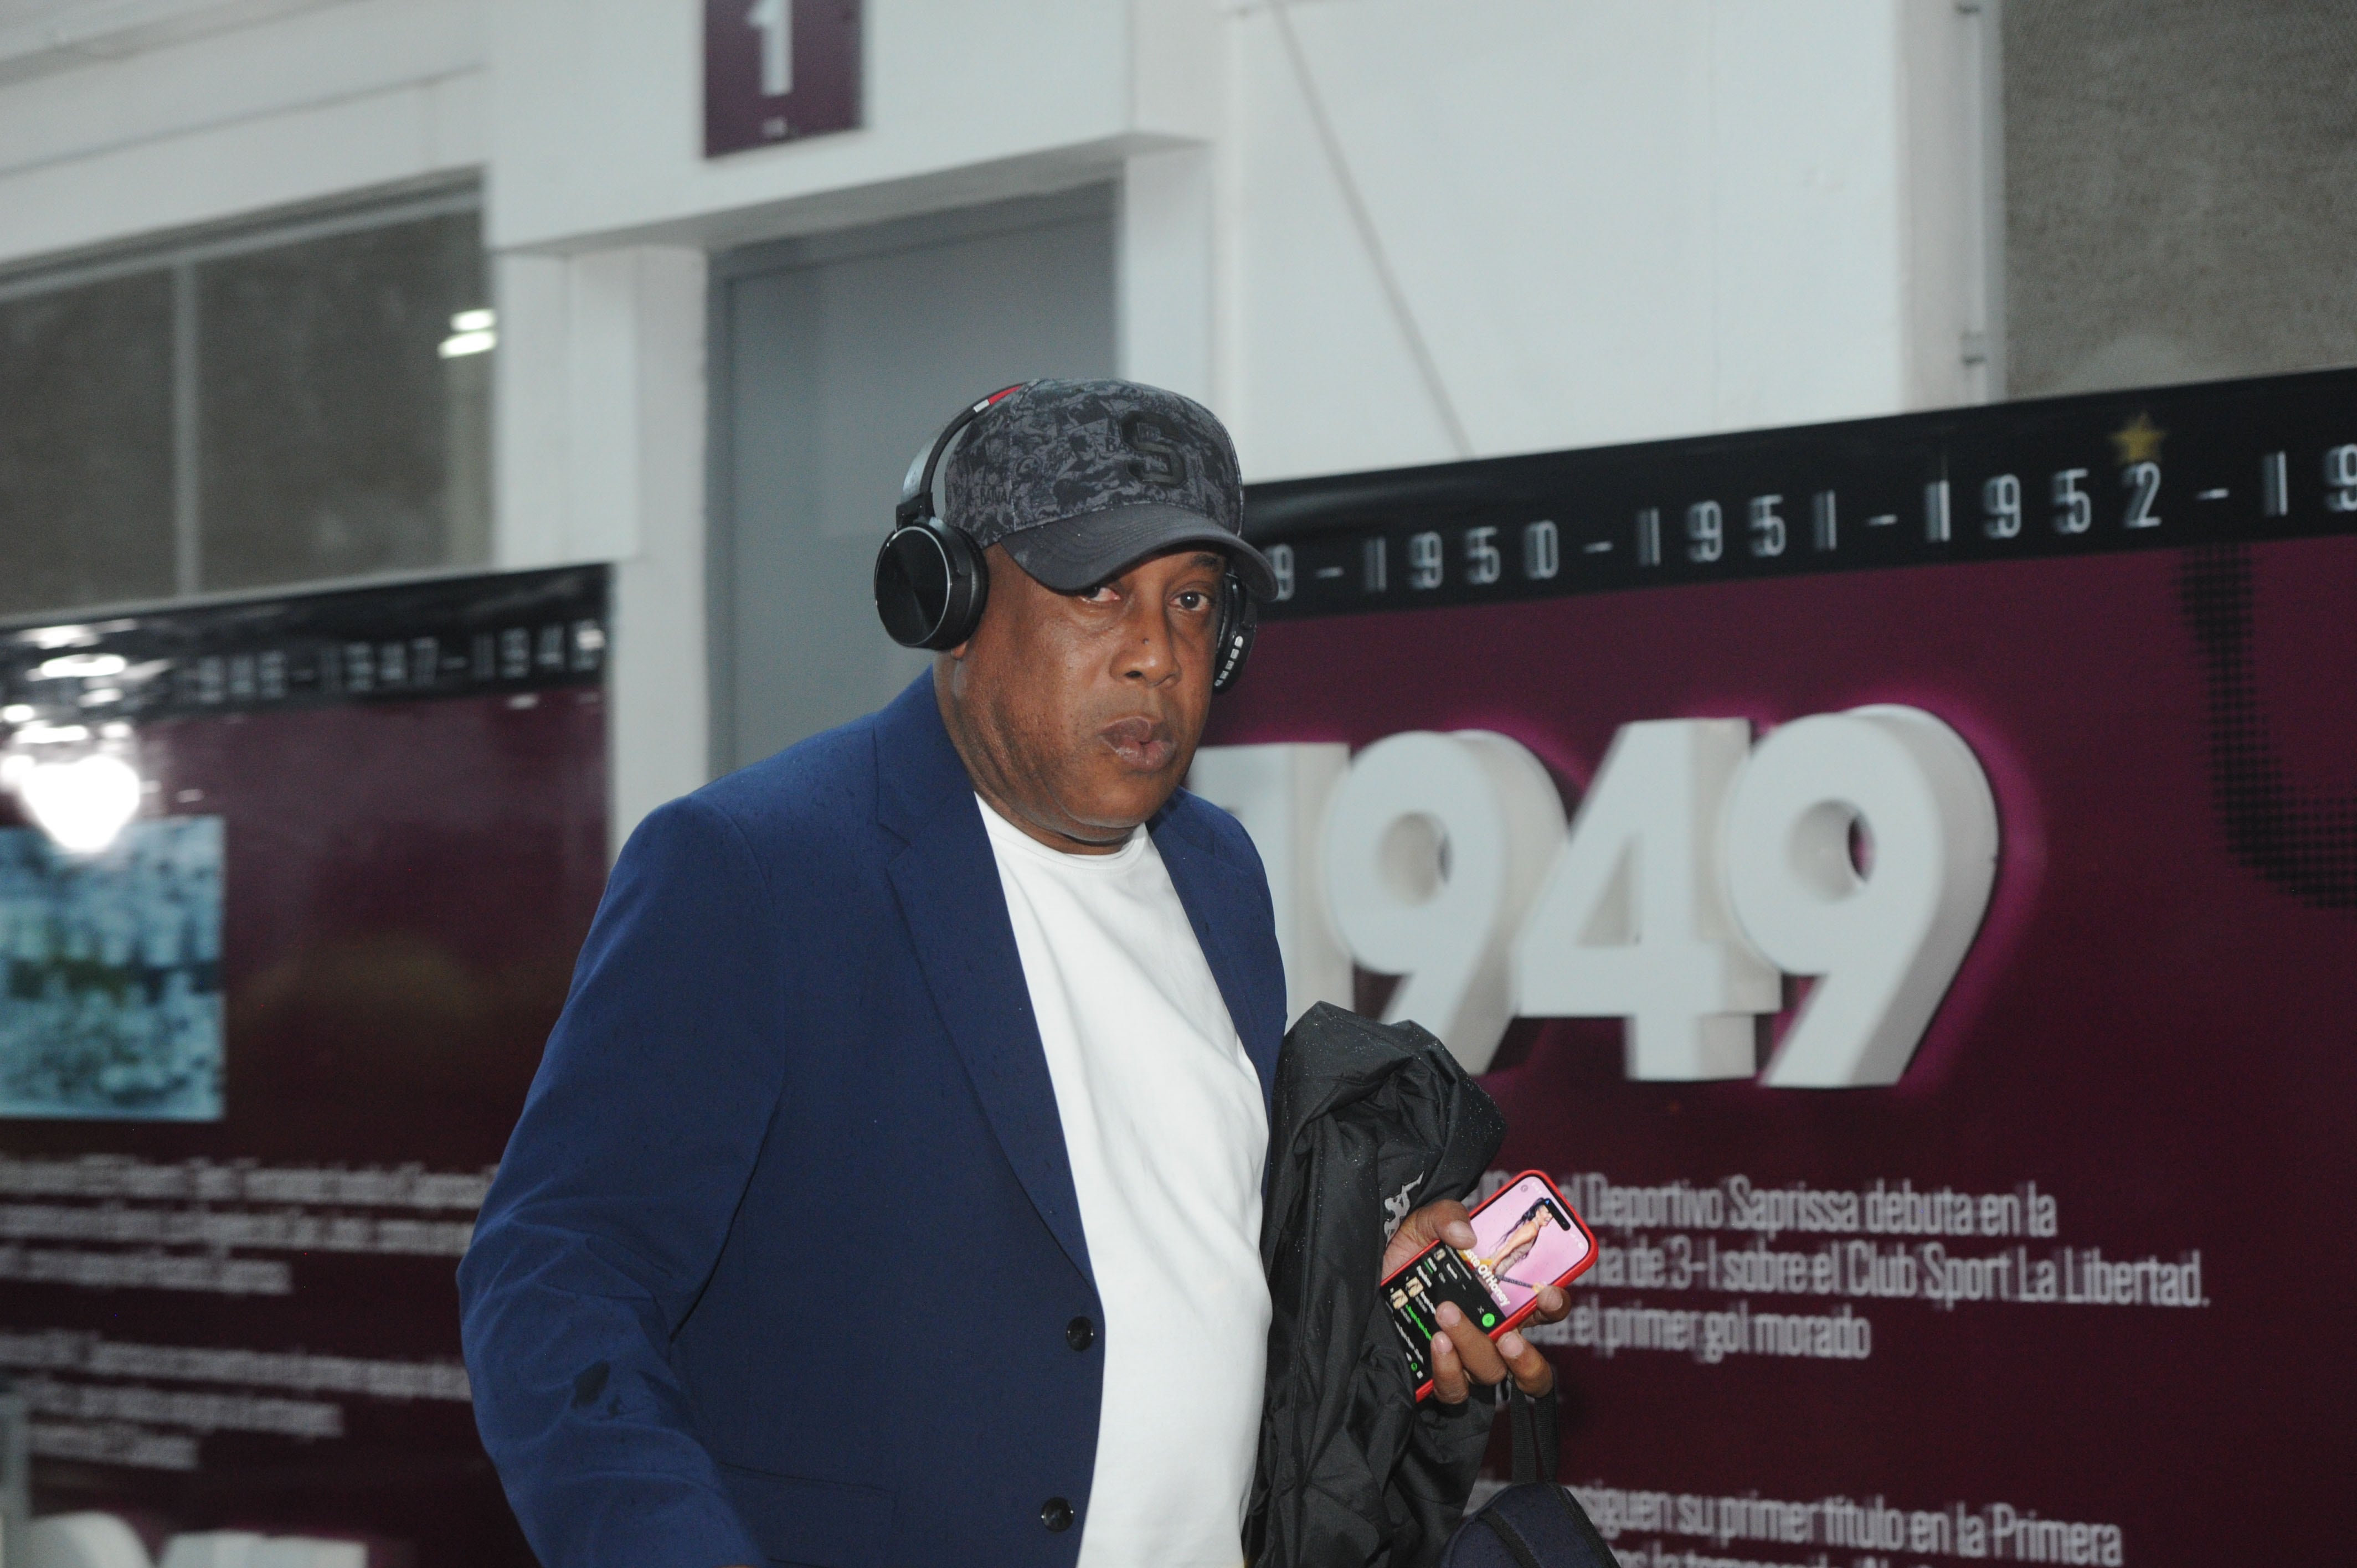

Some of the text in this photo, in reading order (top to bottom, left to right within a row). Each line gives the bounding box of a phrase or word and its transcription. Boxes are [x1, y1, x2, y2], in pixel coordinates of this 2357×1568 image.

[746, 0, 794, 96] 1
[1190, 703, 1999, 1089] 1949
[1585, 1170, 1723, 1237] Deportivo
[1726, 1174, 1859, 1241] Saprissa
[1864, 1178, 1974, 1236] debuta
[1979, 1193, 2020, 1236] en
[2025, 1180, 2058, 1238] la
[1478, 1263, 1493, 1280] Of
[1485, 1274, 1511, 1307] Honey
[1722, 1237, 1808, 1294] sobre
[1812, 1240, 1841, 1294] el
[1846, 1239, 1918, 1297] Club
[1923, 1241, 2011, 1312] Sport
[2018, 1244, 2058, 1303] La
[2063, 1246, 2211, 1308] Libertad.
[1605, 1299, 1699, 1359] primer
[1701, 1299, 1749, 1364] gol
[1754, 1302, 1872, 1359] morado
[1676, 1493, 1715, 1536] su
[1718, 1489, 1820, 1549] primer
[1909, 1509, 1951, 1554] en
[1954, 1499, 1988, 1559] la
[1990, 1501, 2124, 1567] Primera
